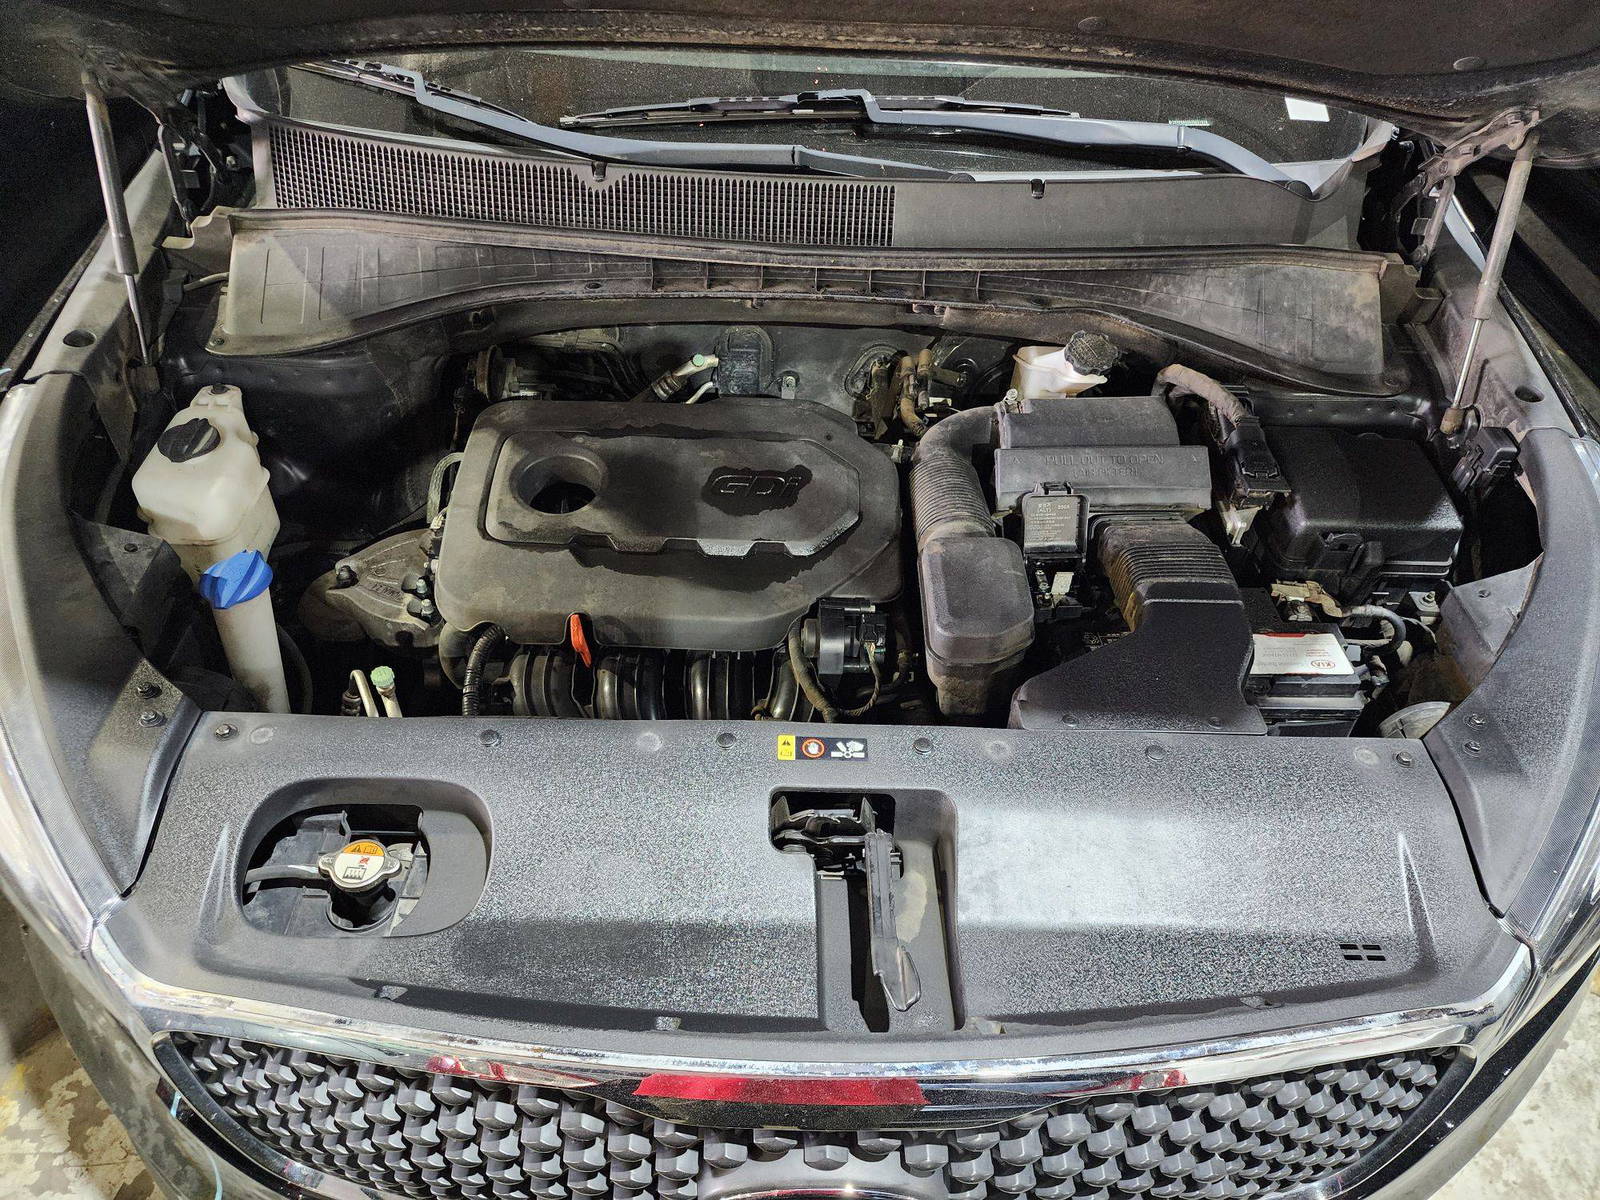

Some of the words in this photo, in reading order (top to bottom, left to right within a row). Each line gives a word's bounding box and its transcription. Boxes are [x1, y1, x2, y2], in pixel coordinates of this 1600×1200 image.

[1044, 454, 1074, 465] PULL
[1080, 454, 1106, 465] OUT
[1110, 454, 1129, 465] TO
[1130, 454, 1165, 465] OPEN
[1312, 660, 1335, 669] KIA
